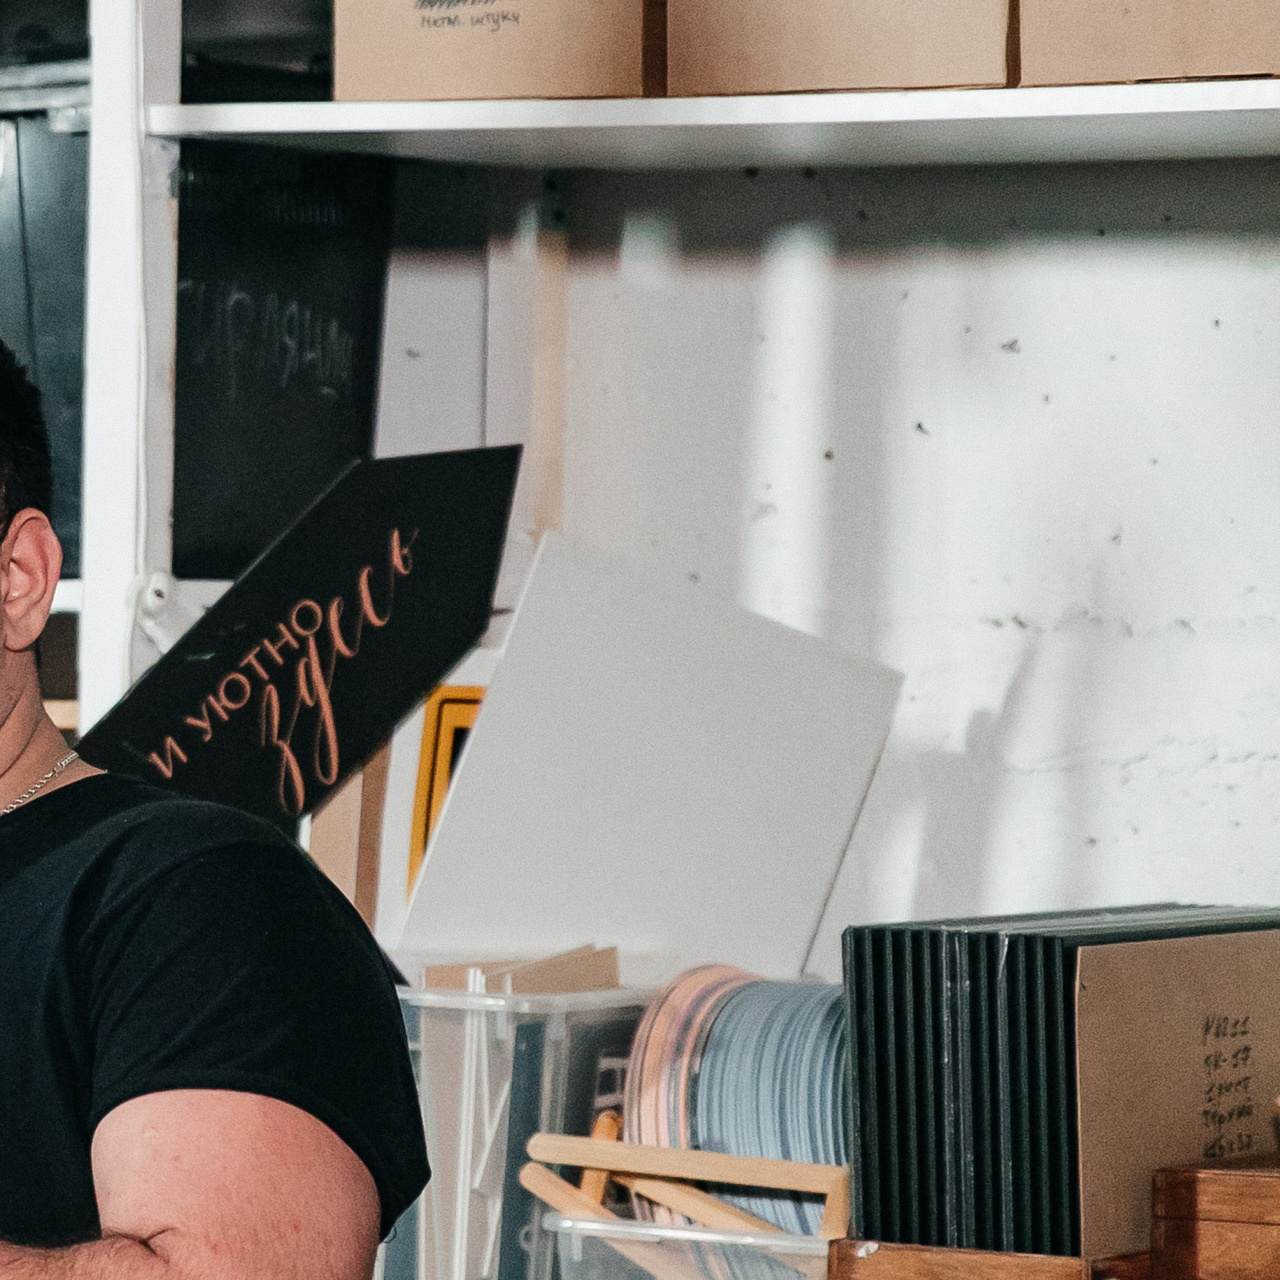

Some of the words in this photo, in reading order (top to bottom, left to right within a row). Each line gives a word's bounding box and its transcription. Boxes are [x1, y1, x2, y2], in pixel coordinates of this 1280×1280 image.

[148, 736, 188, 779] И
[185, 598, 324, 742] УЮТНО
[261, 527, 419, 816] здесь
